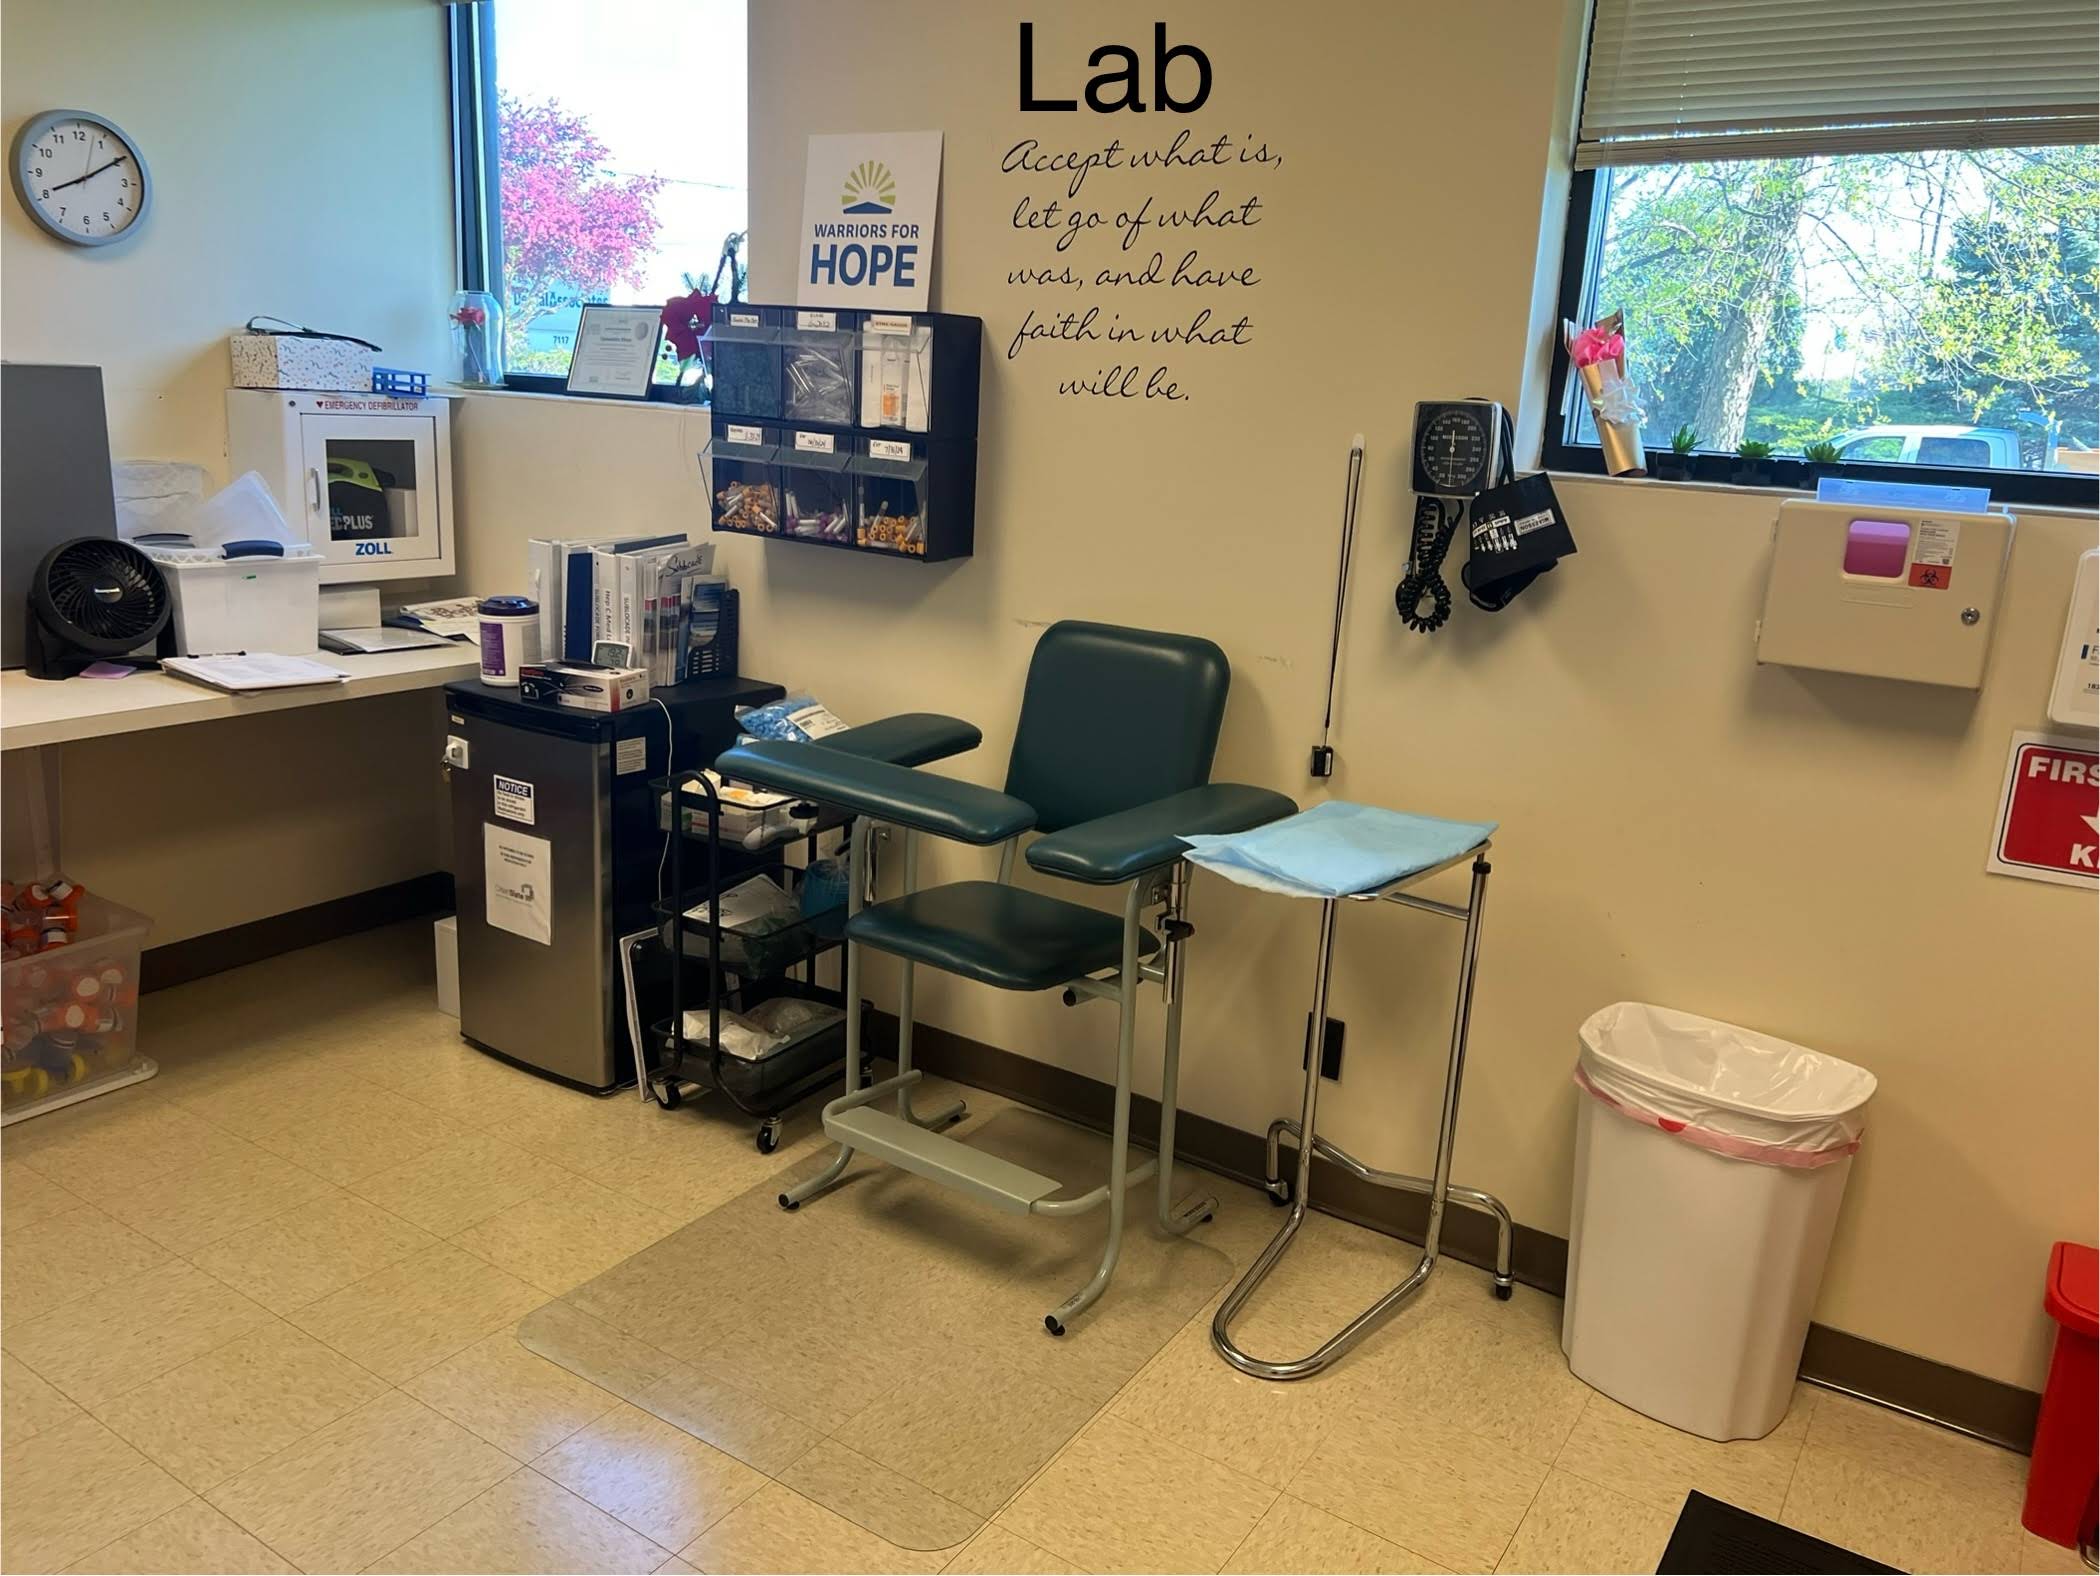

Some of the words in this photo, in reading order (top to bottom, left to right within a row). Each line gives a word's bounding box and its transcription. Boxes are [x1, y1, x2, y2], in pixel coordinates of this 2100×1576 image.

[53, 134, 64, 144] 11
[72, 131, 86, 141] 12
[98, 140, 104, 149] 1
[39, 148, 52, 158] 10
[1001, 139, 1125, 198] Accept
[1130, 129, 1233, 169] what
[1240, 134, 1282, 170] is,
[35, 168, 43, 177] 9
[121, 178, 128, 188] 3
[42, 189, 50, 199] 8
[117, 198, 124, 206] 4
[59, 207, 66, 216] 7
[103, 212, 110, 221] 5
[83, 215, 90, 225] 6
[1012, 196, 1062, 229] let
[1055, 211, 1108, 252] go
[1115, 196, 1153, 251] of
[1158, 190, 1263, 228] what
[813, 223, 888, 239] WARRIORS
[891, 223, 920, 239] FOR
[809, 243, 919, 288] HOPE
[1007, 266, 1083, 291] was,
[1095, 252, 1166, 286] and
[1171, 250, 1262, 287] have
[1007, 307, 1101, 360] faith
[1108, 314, 1145, 343] in
[1152, 309, 1254, 345] what
[1059, 366, 1139, 398] will
[1145, 367, 1190, 401] be.
[324, 401, 367, 410] EMERGENCY
[368, 401, 419, 411] DEFIBRILLATOR
[355, 542, 392, 555] ZOLL
[498, 780, 529, 797] NOTICE
